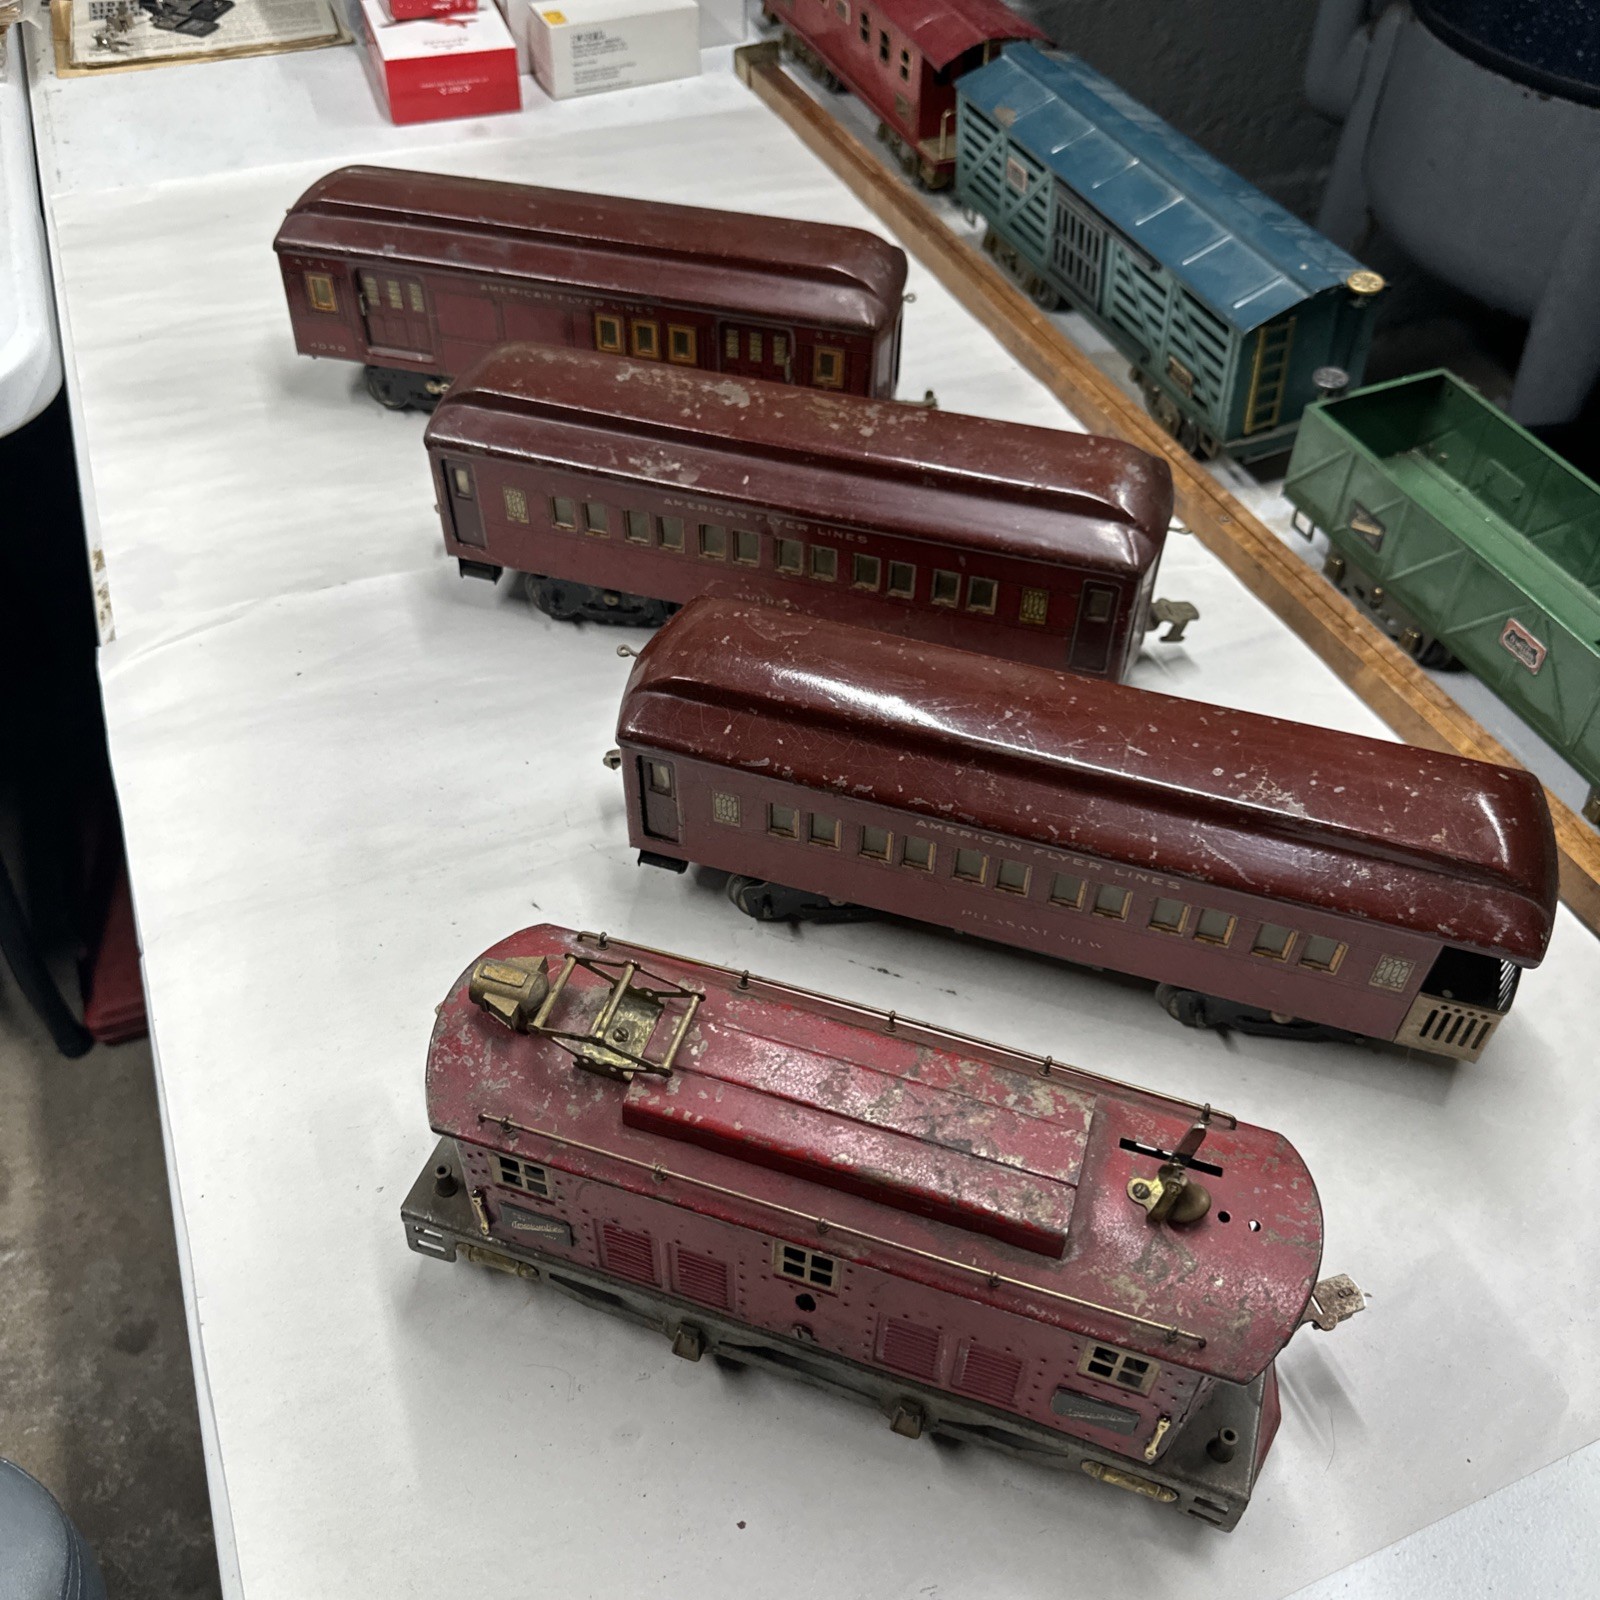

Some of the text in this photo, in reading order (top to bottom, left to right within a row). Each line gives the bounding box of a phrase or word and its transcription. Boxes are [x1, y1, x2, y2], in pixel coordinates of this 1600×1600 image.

[480, 284, 655, 316] AMERICAN FLYER LINES
[663, 498, 868, 545] AMERICAN FLYER LINES
[915, 819, 1181, 891] AMERICAN FLYER LINES
